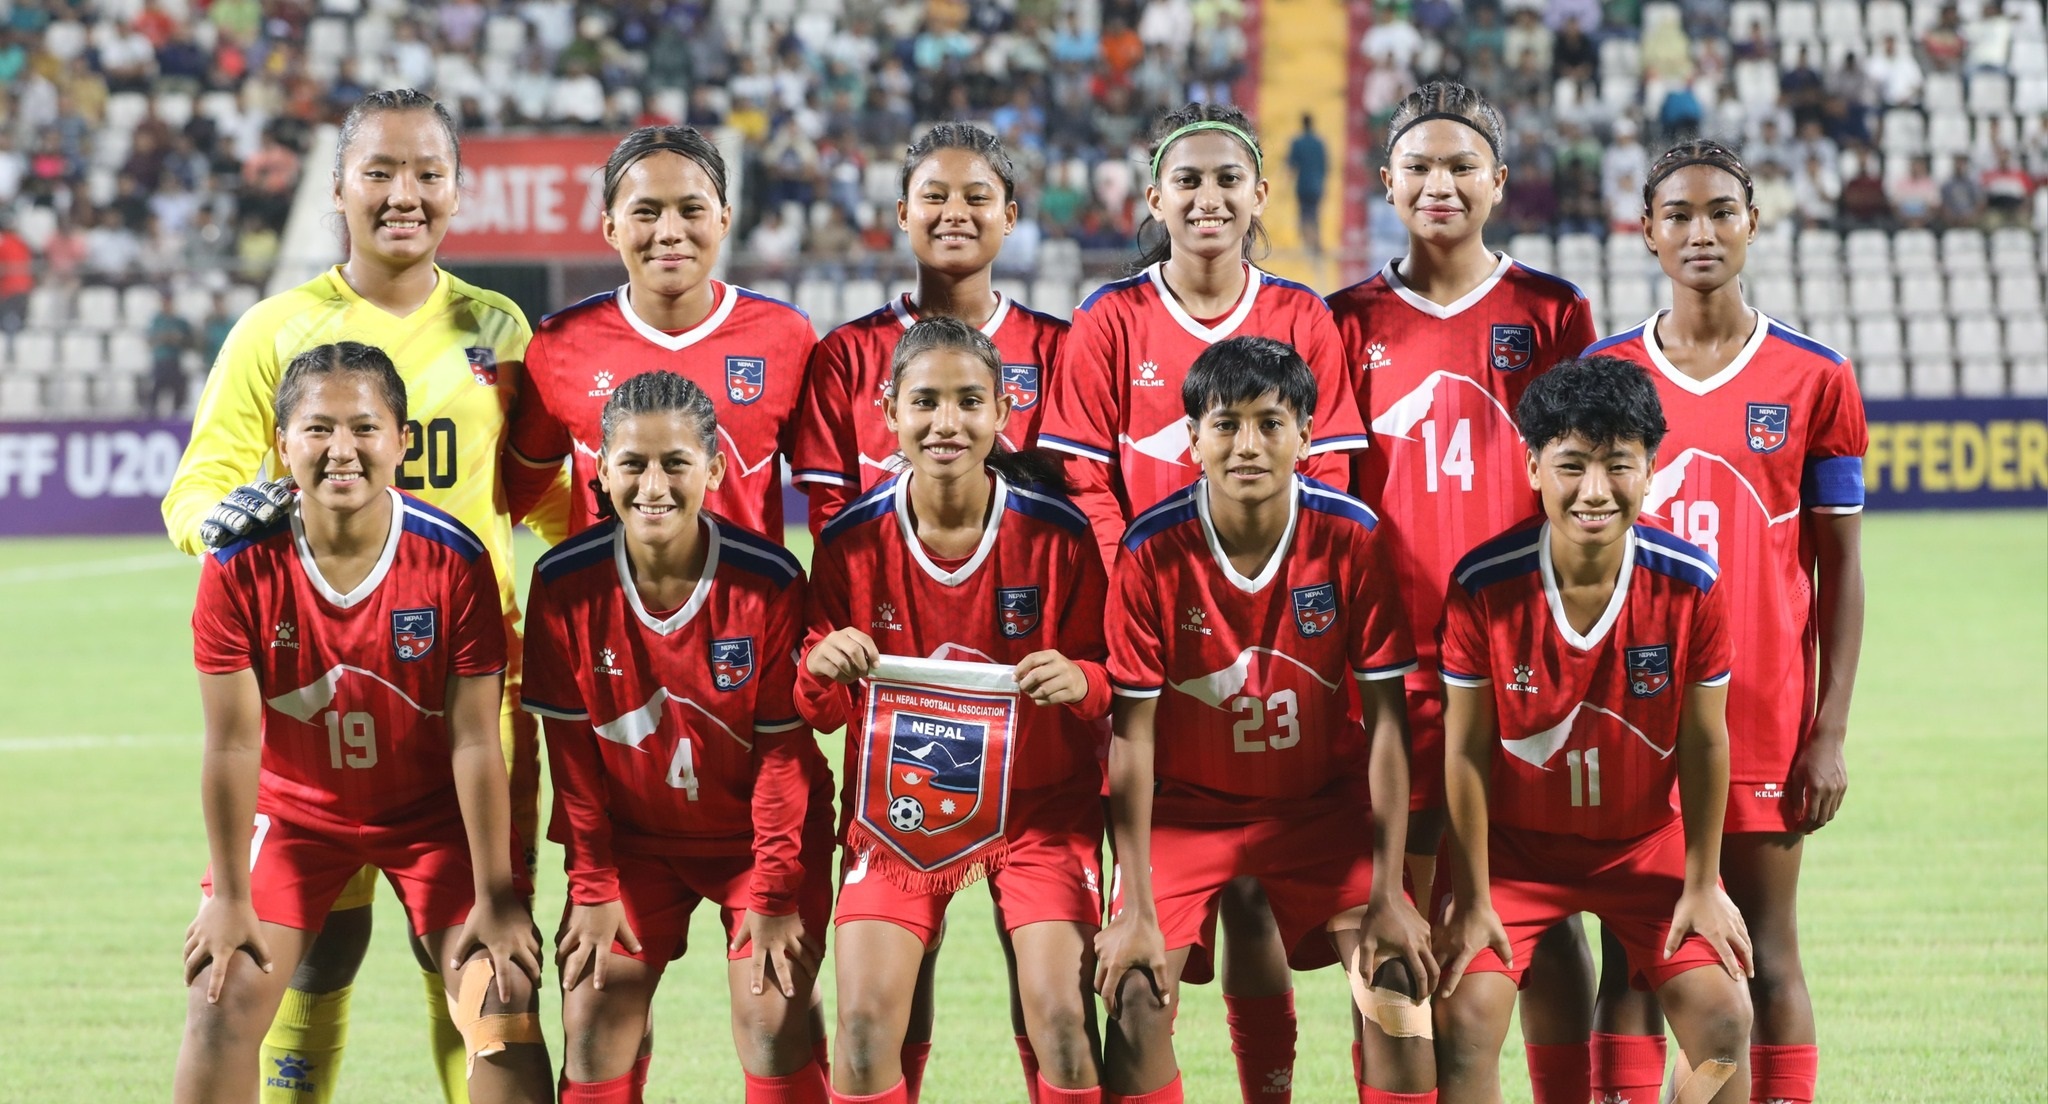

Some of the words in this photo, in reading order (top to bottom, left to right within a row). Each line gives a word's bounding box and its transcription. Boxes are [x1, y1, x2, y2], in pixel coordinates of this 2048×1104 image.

[1011, 367, 1029, 375] NEPAL
[1362, 358, 1392, 371] KELME
[1132, 379, 1165, 387] KELME
[588, 384, 617, 398] KELM
[1758, 408, 1778, 416] NEPAL
[394, 417, 458, 491] 20
[1422, 418, 1475, 493] 14
[65, 430, 181, 499] U20
[1008, 592, 1028, 600] NEPAL
[1304, 590, 1324, 599] NEPAL
[404, 614, 424, 622] NEPAL
[871, 621, 903, 631] KELME
[1181, 623, 1212, 636] KELME
[271, 640, 300, 650] KELME
[720, 644, 740, 652] NEPAL
[1638, 651, 1658, 659] NEPAL
[594, 665, 623, 676] KELME
[1506, 682, 1539, 694] KELME
[881, 692, 895, 703] ALL
[896, 694, 919, 706] NEPAL
[920, 698, 956, 712] FOOTBALL
[958, 703, 1005, 717] ASSOCIATION
[1231, 688, 1301, 753] 23
[912, 720, 966, 741] NEPAL
[324, 710, 379, 769] 19
[664, 737, 700, 801] 4
[1566, 747, 1601, 807] 11
[267, 1076, 316, 1093] KELME
